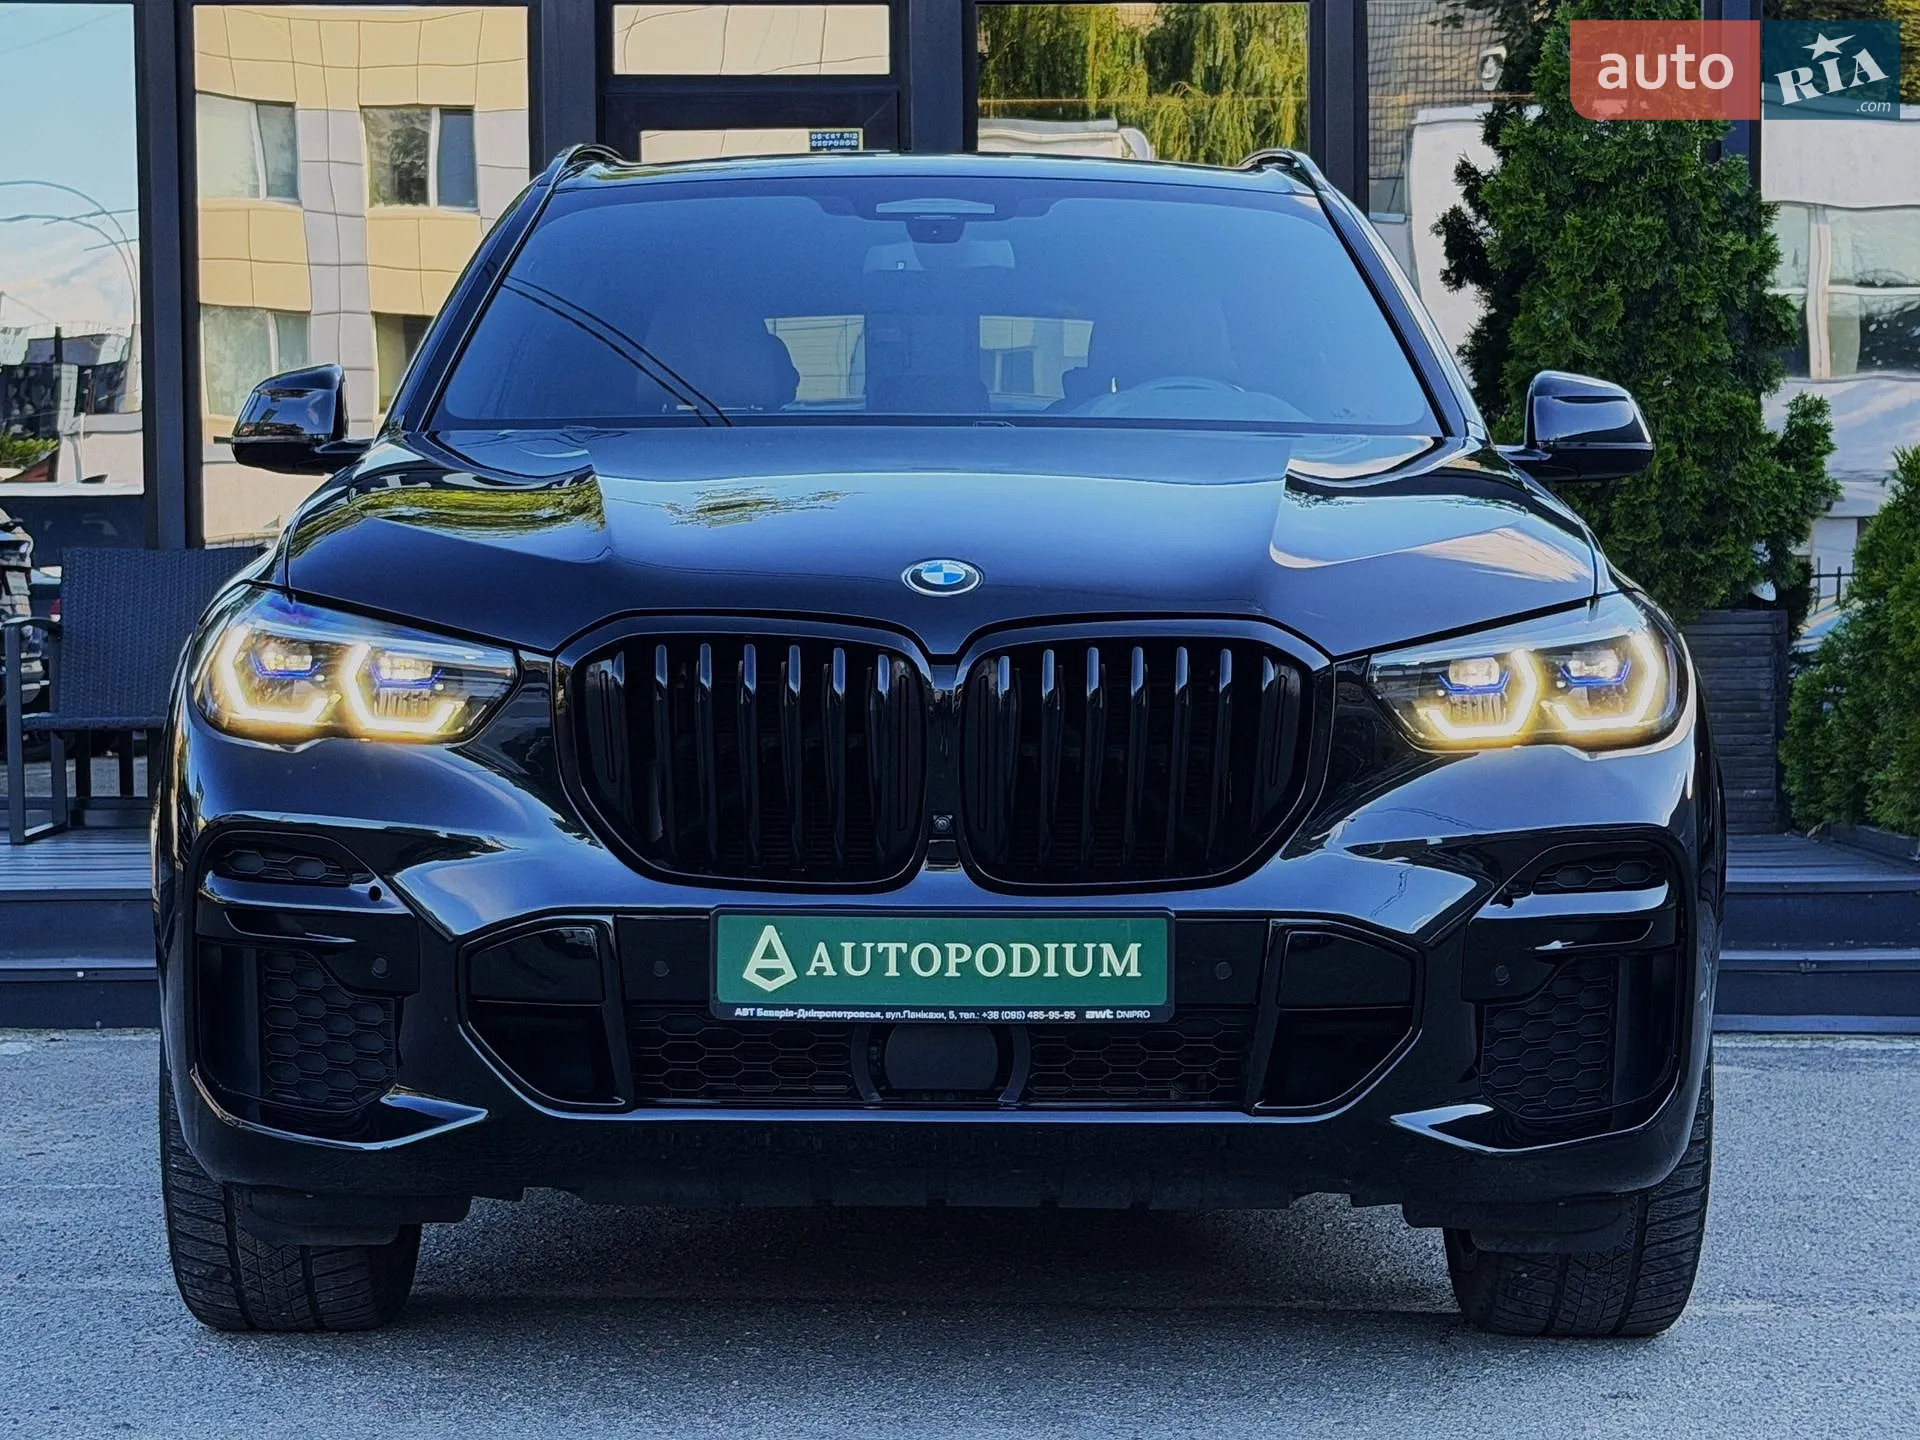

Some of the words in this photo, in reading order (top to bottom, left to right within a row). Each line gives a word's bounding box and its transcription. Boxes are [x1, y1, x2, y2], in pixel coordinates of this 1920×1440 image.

[806, 941, 1142, 978] AUTOPODIUM
[982, 1010, 999, 1019] +38
[1116, 1010, 1151, 1019] DNIPRO
